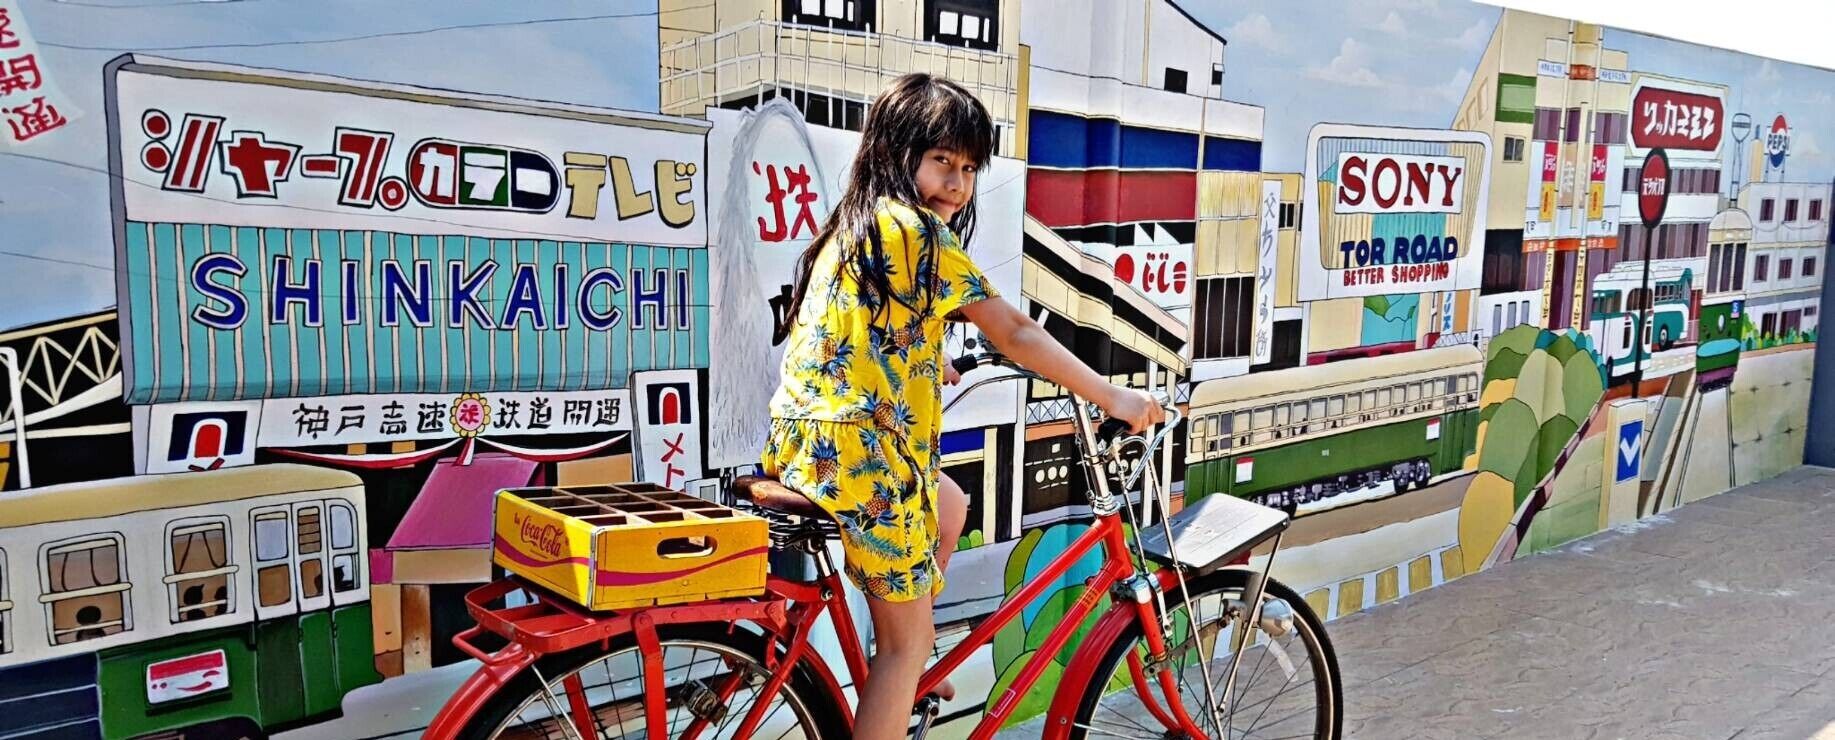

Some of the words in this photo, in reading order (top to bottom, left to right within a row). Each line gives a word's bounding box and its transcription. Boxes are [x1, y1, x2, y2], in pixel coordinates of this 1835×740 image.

[1767, 133, 1790, 151] PEPSI
[1339, 155, 1462, 209] SONY
[1340, 237, 1386, 269] TOR
[1392, 234, 1459, 265] ROAD
[191, 252, 691, 331] SHINKAICHI
[1343, 267, 1384, 287] BETTER
[1391, 261, 1449, 284] SHOPPING
[520, 514, 564, 558] Coca-Cola
